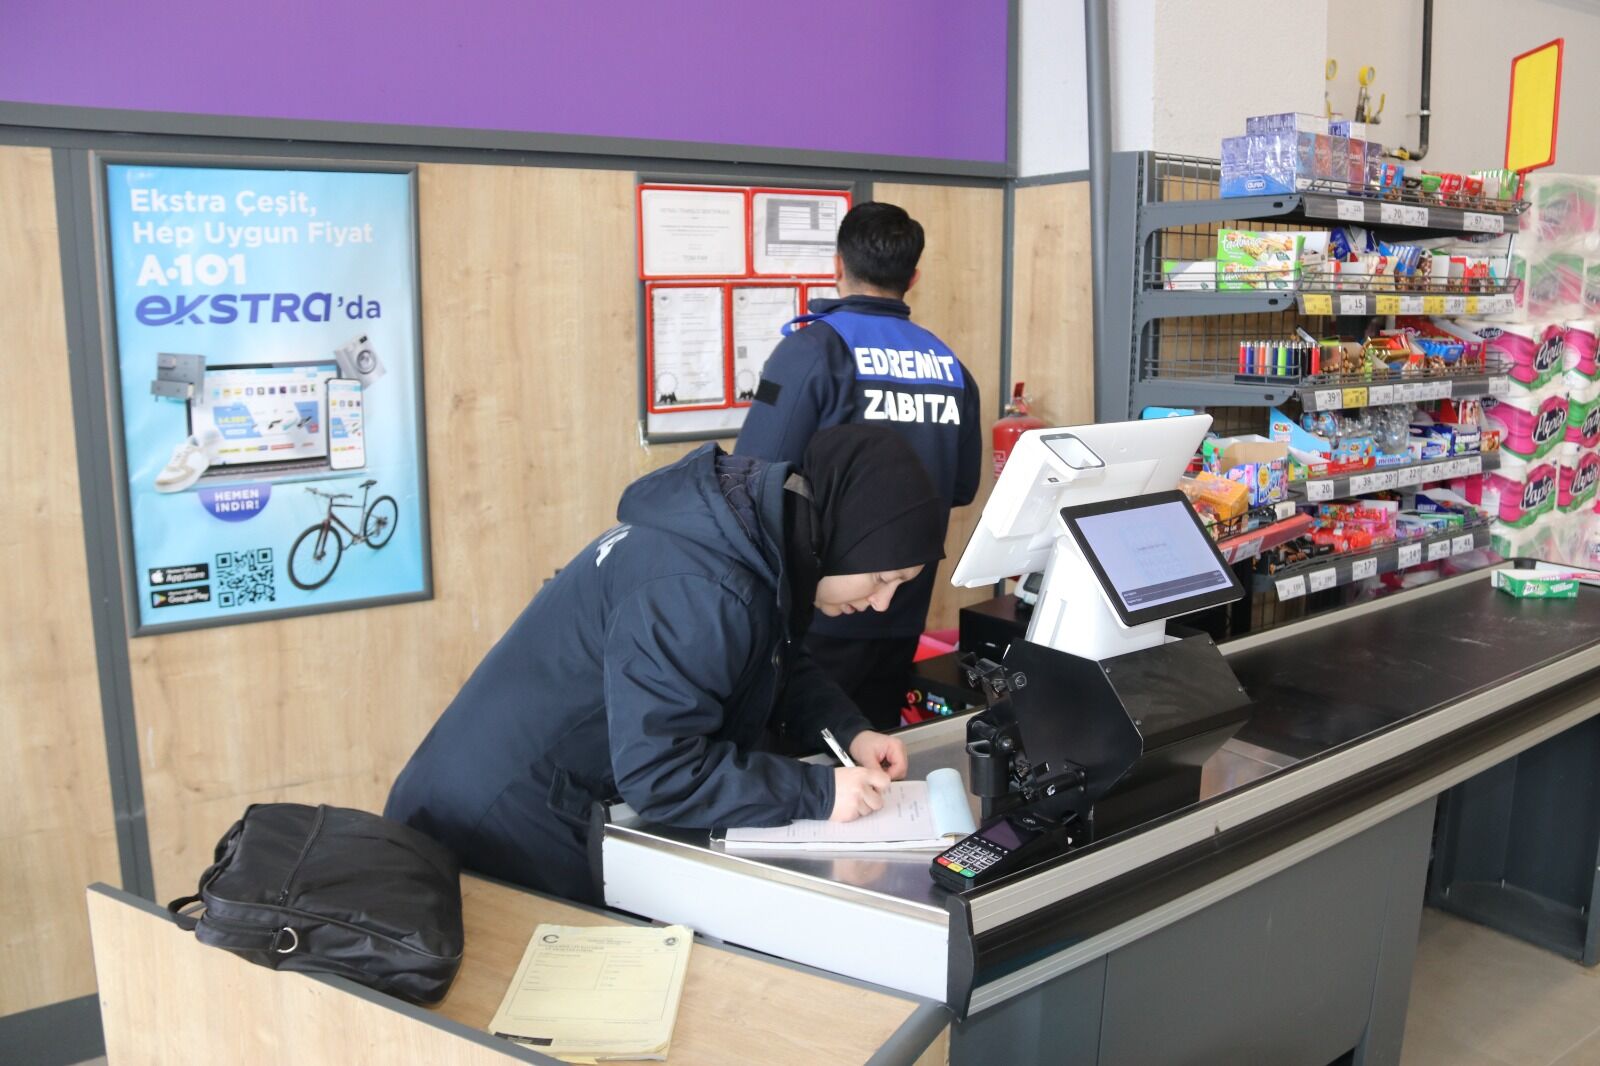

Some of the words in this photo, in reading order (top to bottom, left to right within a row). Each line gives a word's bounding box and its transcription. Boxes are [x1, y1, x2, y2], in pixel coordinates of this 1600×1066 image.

[130, 188, 225, 213] Ekstra
[235, 190, 317, 218] Çeşit,
[133, 221, 194, 247] Hep
[205, 221, 298, 248] Uygun
[308, 222, 373, 247] Fiyat
[854, 347, 954, 382] EDREMİT
[864, 389, 961, 425] ZABITA
[214, 489, 259, 502] HEMEN
